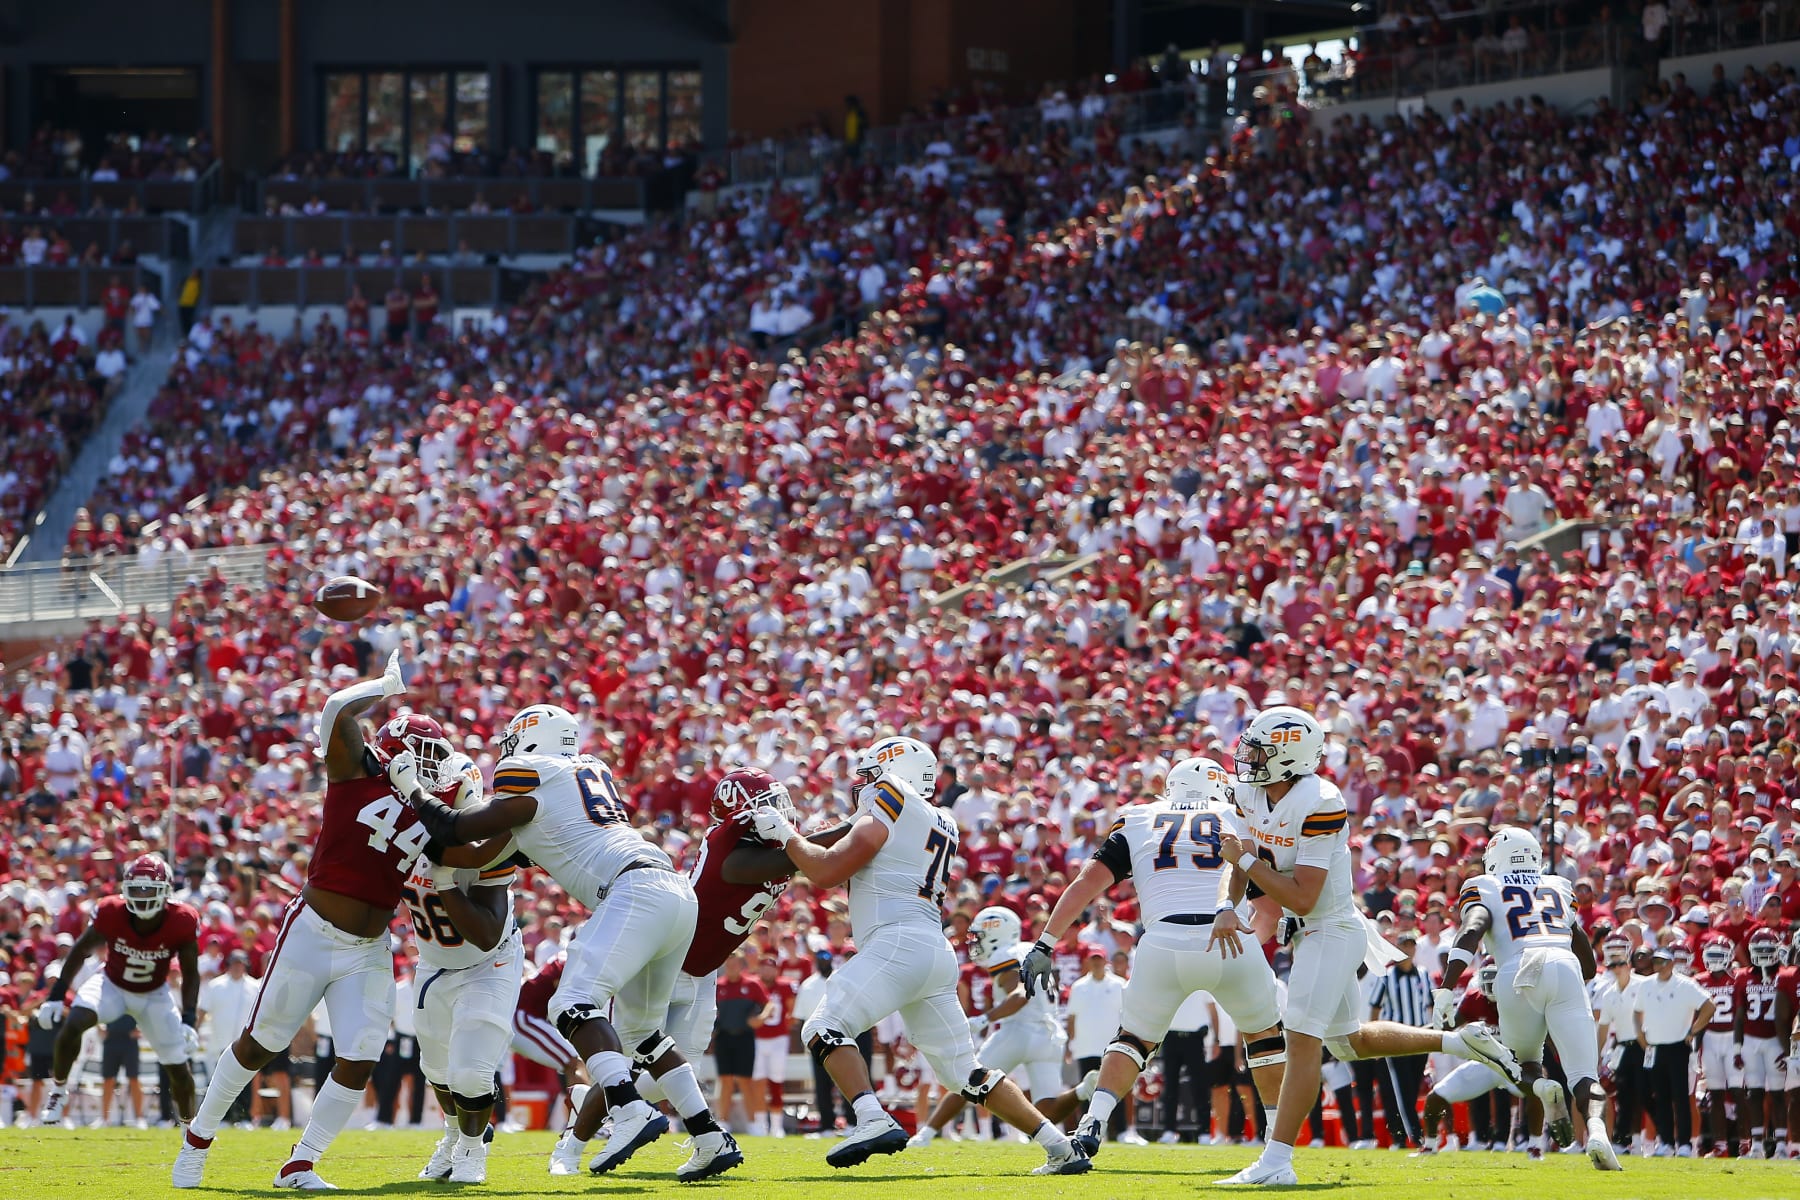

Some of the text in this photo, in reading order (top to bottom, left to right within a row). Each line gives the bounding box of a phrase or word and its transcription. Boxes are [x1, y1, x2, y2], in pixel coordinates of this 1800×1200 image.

[513, 715, 540, 733] 915
[1269, 730, 1302, 744] 915
[876, 745, 906, 764] 915
[1207, 771, 1229, 785] 915
[356, 794, 431, 873] 44
[1152, 813, 1224, 872] 79
[1248, 826, 1295, 848] MINERS
[411, 874, 436, 889] NE
[400, 885, 465, 948] 66
[723, 891, 774, 936] 9
[1502, 886, 1565, 941] 22
[114, 942, 170, 961] SOONERS
[122, 957, 157, 983] 2
[1745, 984, 1777, 994] SOONER
[1709, 995, 1734, 1023] 2
[1746, 993, 1777, 1020] 37
